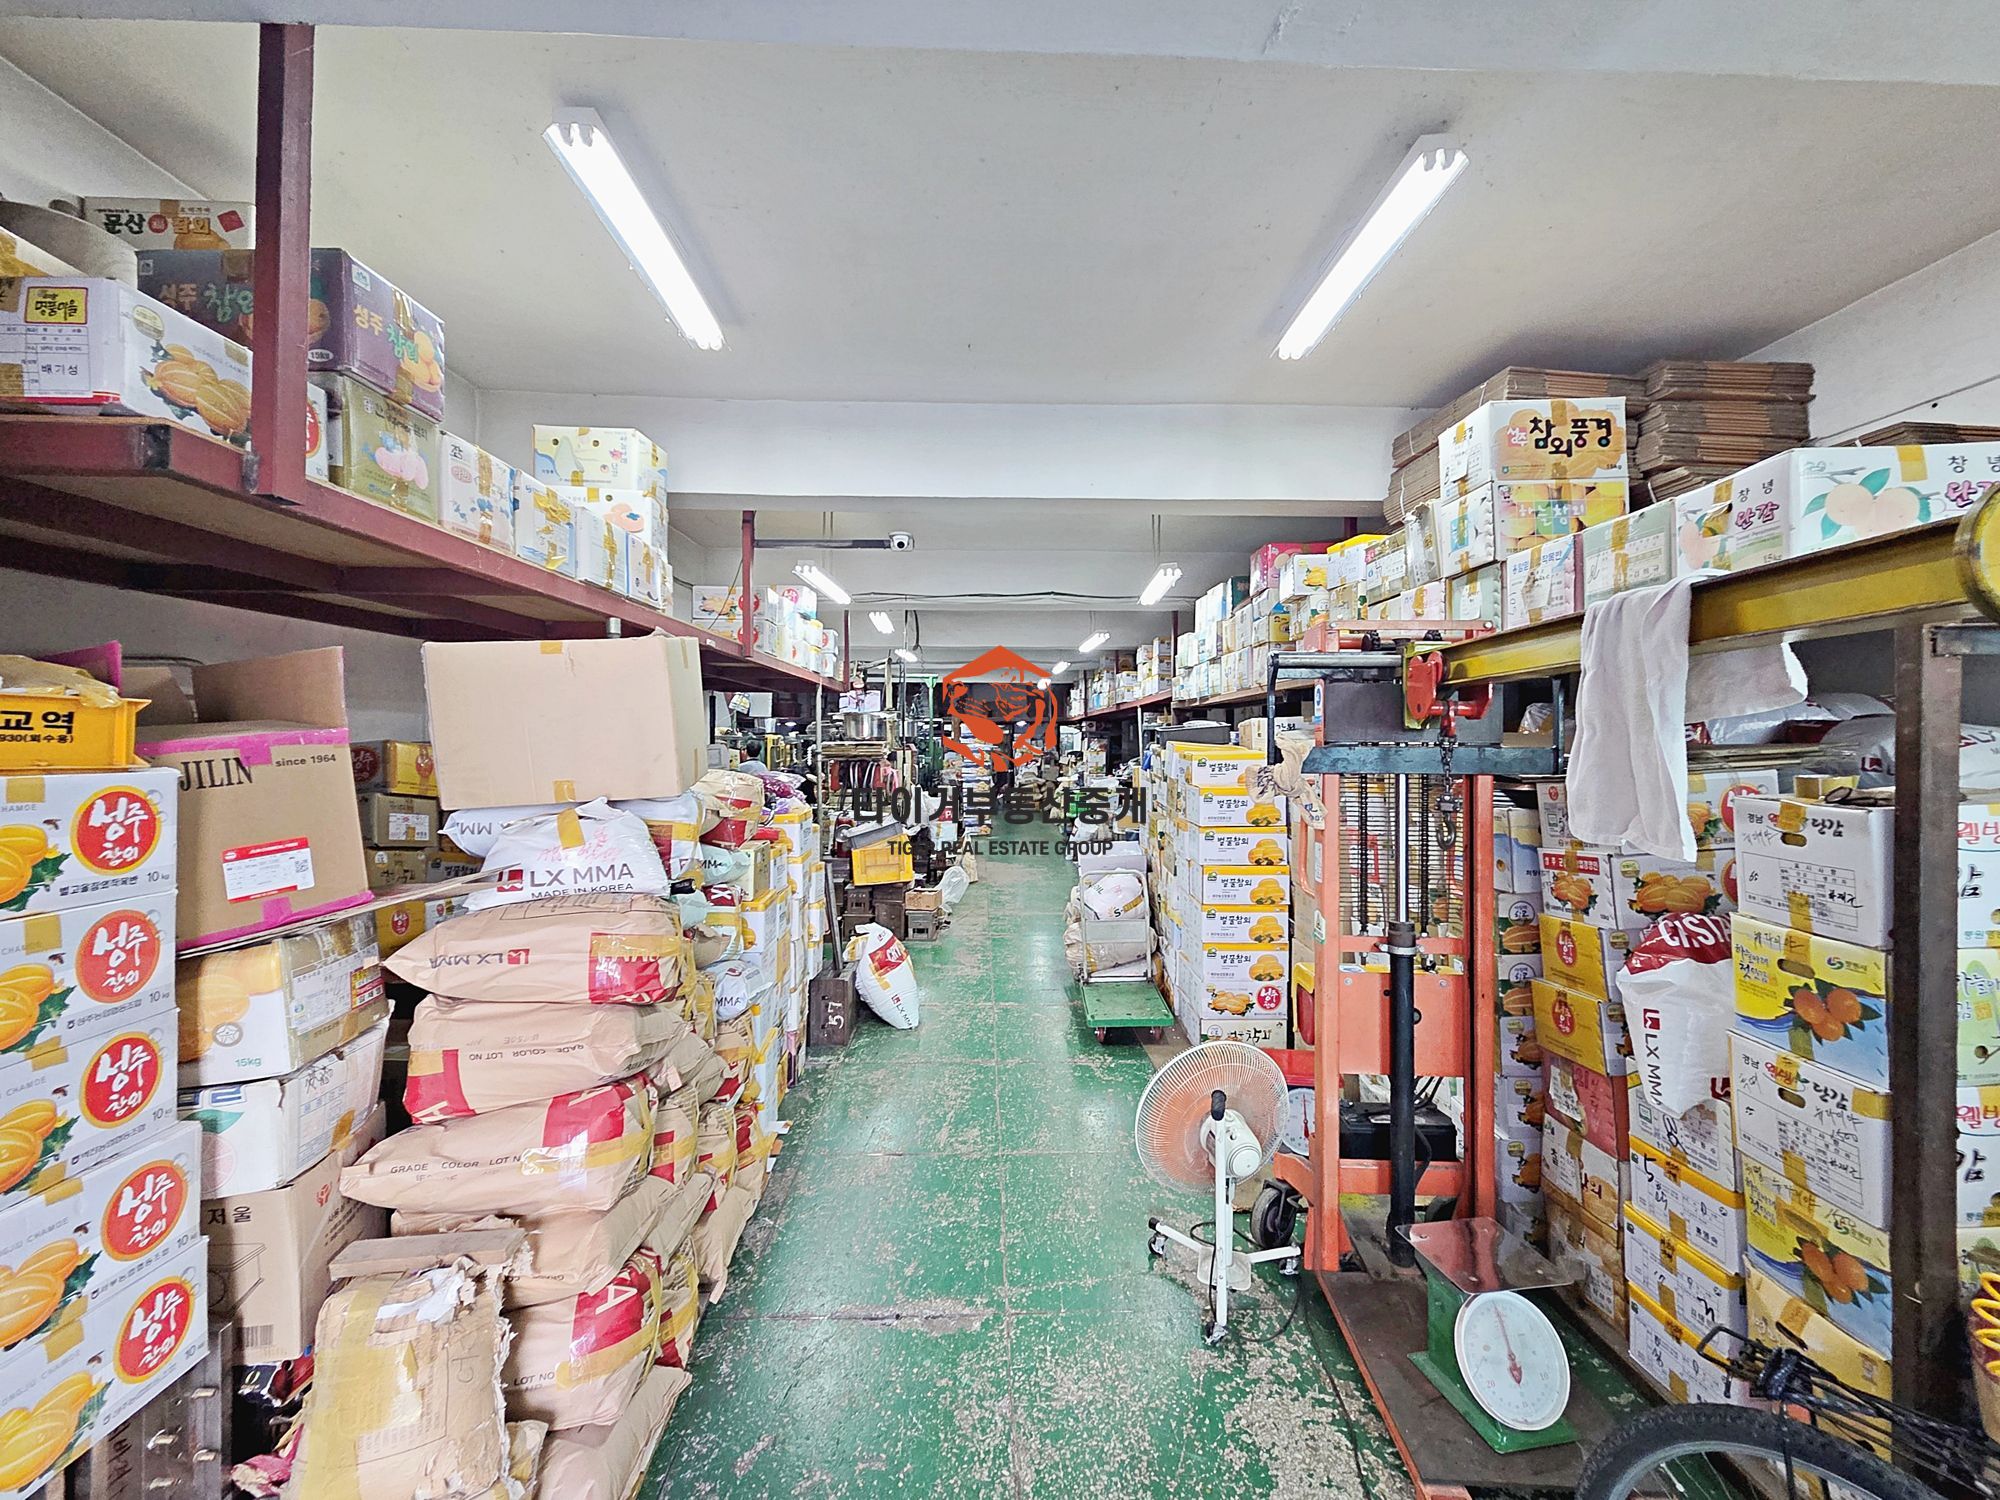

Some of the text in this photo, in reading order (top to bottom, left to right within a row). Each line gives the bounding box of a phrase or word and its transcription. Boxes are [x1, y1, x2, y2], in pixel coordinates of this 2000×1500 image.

[103, 213, 146, 235] 문산
[353, 303, 383, 336] 성주
[1735, 501, 1780, 531] 단감
[179, 754, 337, 791] JILIN since 1964
[1811, 817, 1844, 838] 단감
[530, 863, 634, 888] LX MMA
[592, 883, 634, 893] KOREA
[477, 952, 504, 965] LX
[485, 1052, 503, 1061] LOT
[512, 1048, 546, 1058] COLOR
[1645, 1033, 1661, 1060] LX
[234, 1058, 262, 1068] 15kg
[469, 1053, 483, 1062] NO
[1813, 1081, 1849, 1111] 단감
[390, 1162, 428, 1174] GRADE
[441, 1160, 479, 1170] COLOR
[489, 1157, 511, 1167] LOT
[207, 1205, 252, 1226] 저울
[514, 1371, 555, 1387] LOT NO
